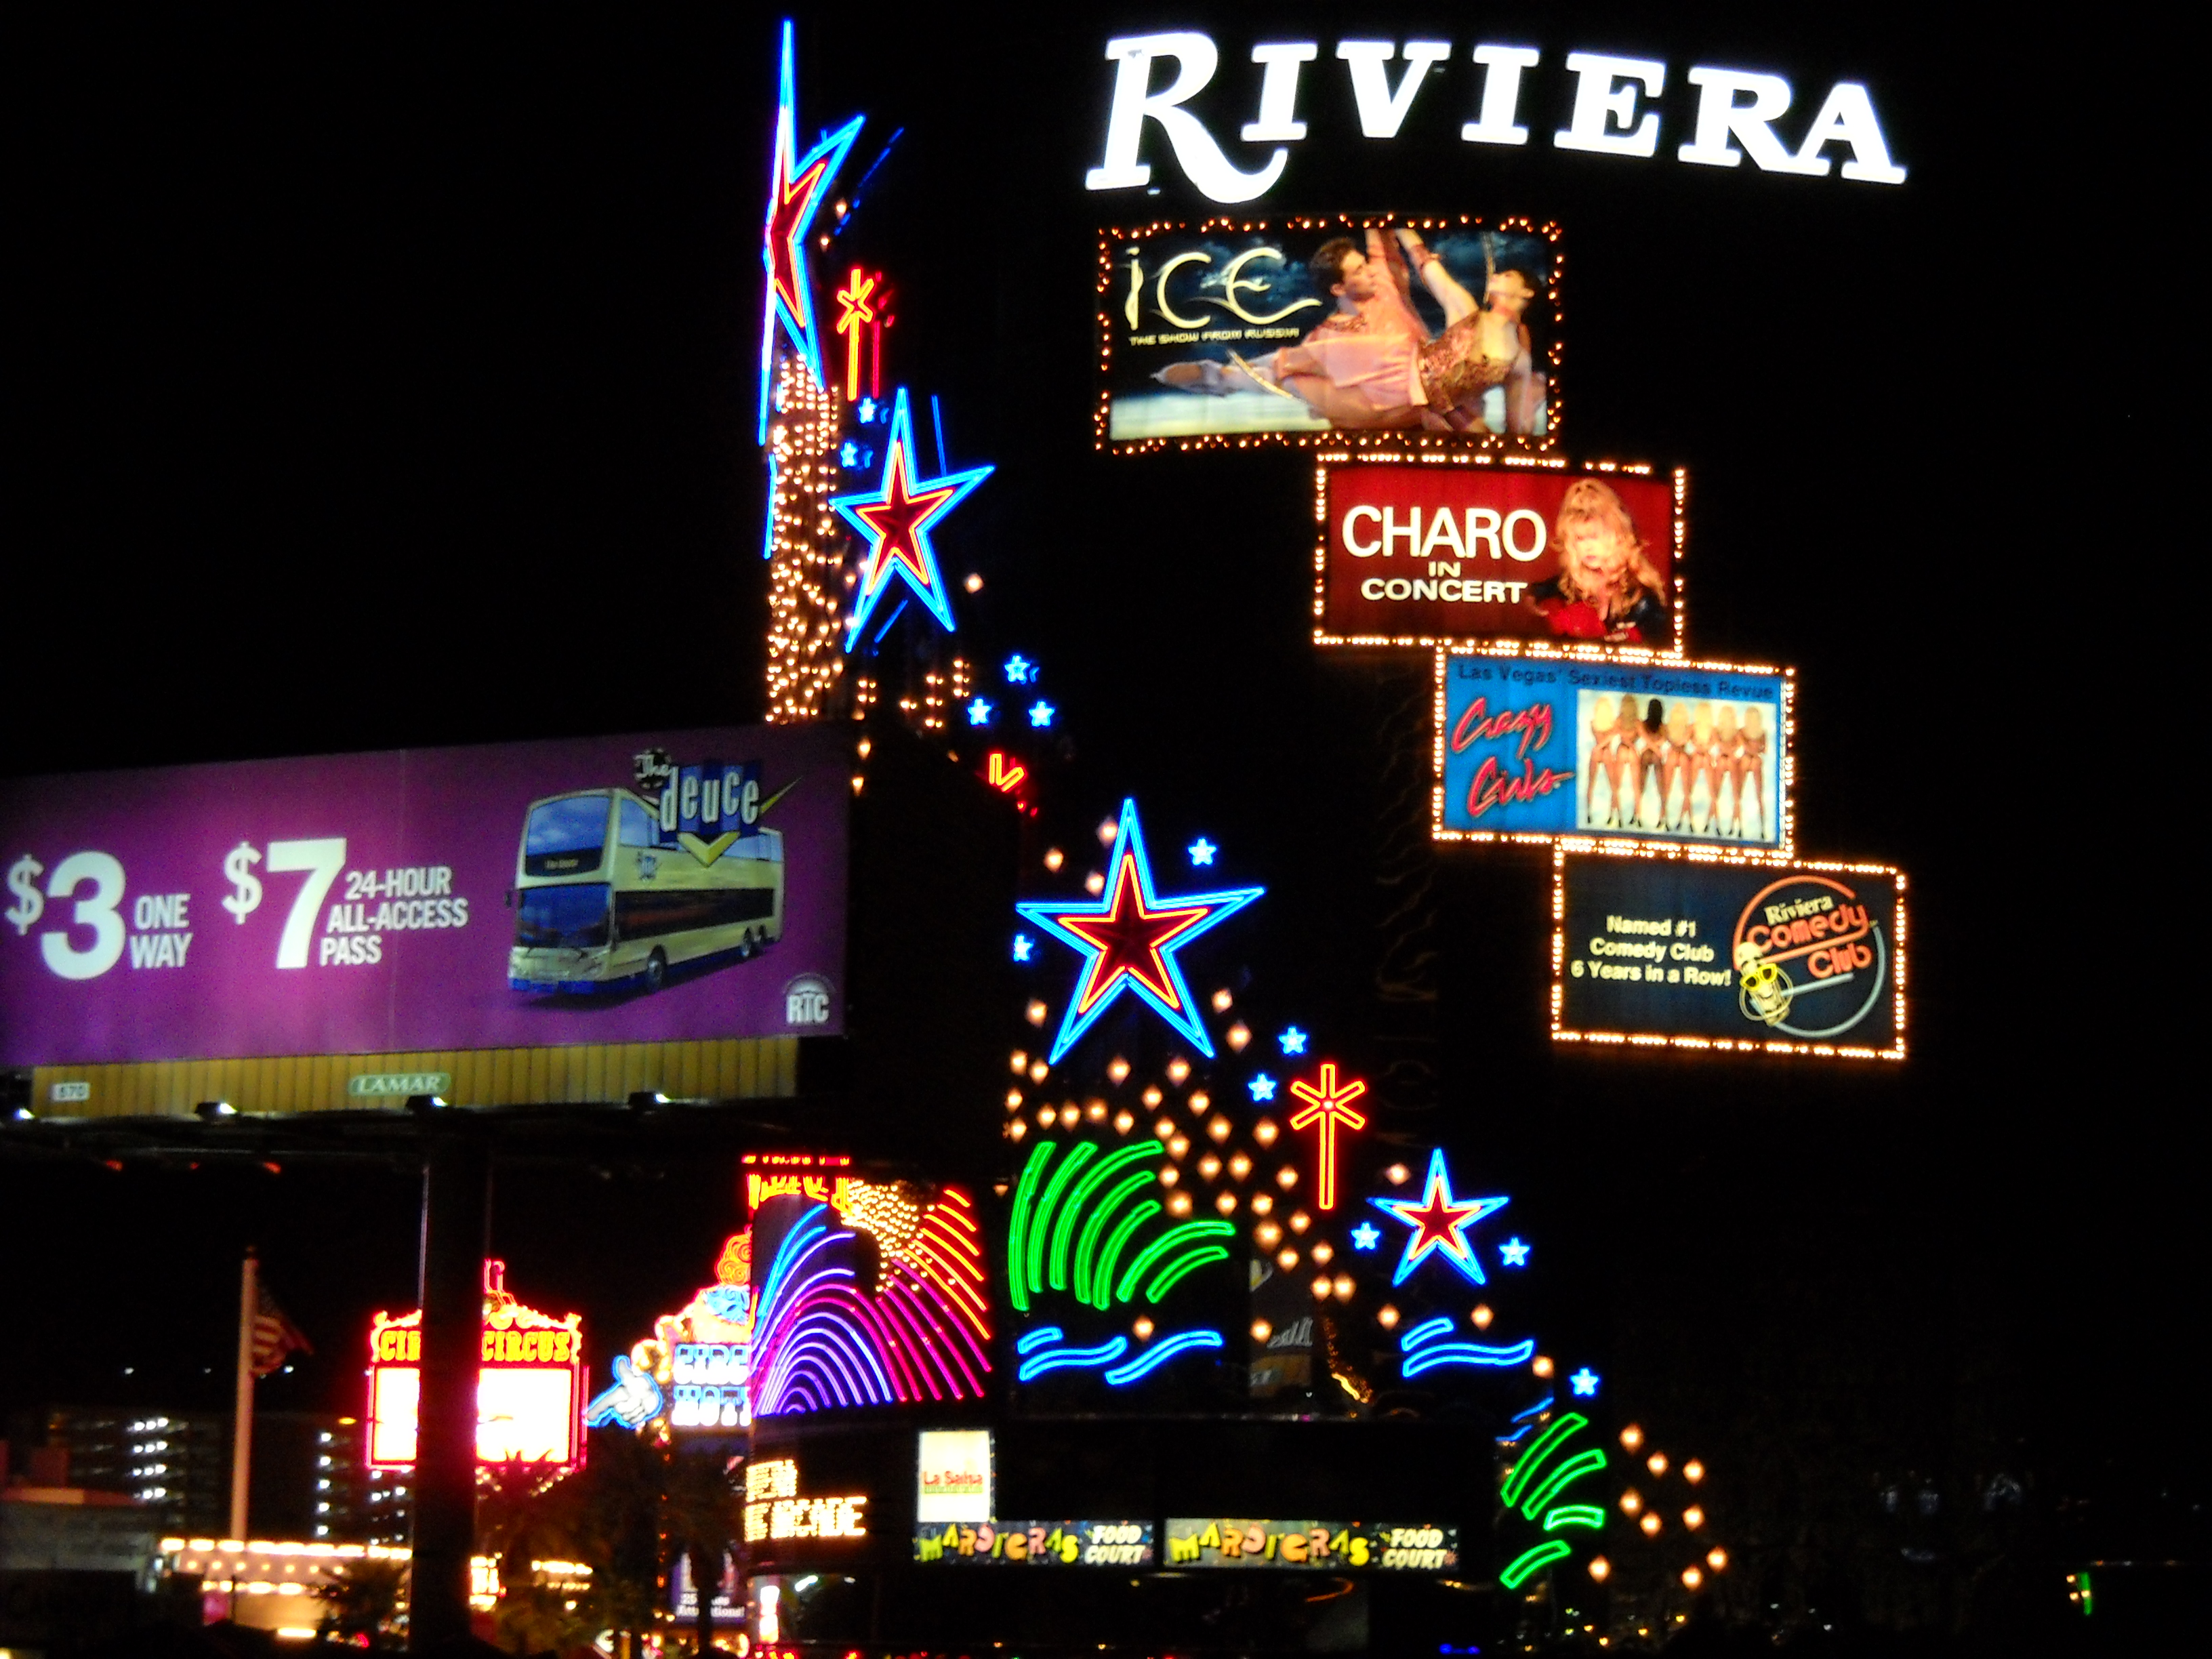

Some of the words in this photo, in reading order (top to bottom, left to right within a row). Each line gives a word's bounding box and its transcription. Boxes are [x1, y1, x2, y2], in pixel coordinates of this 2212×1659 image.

[1085, 31, 1907, 204] RIVIERA
[1130, 336, 1156, 346] THE
[1158, 332, 1200, 345] SHOW
[1201, 330, 1243, 341] FROM
[1245, 328, 1300, 340] RUSSIA
[1342, 505, 1547, 561] CHARO
[1428, 561, 1461, 578] IN
[1360, 577, 1528, 603] CONCERT
[1458, 663, 1492, 681] Las
[1568, 668, 1636, 687] Sexiest
[1641, 674, 1712, 696] Topless
[1717, 680, 1774, 699] Revue
[1451, 697, 1551, 760] Crazy
[633, 752, 671, 781] The
[1467, 756, 1575, 817] Girls
[345, 865, 452, 901] 24-HOUR
[5, 851, 126, 980] $3
[135, 893, 190, 930] ONE
[222, 838, 347, 969] $7
[327, 898, 468, 935] ALL-ACCESS
[1764, 895, 1834, 926] Riviera
[1606, 915, 1671, 937] Named
[1675, 920, 1696, 938] #1
[1746, 903, 1870, 953] Comedy
[130, 932, 192, 969] WAY
[319, 935, 382, 966] PASS
[1589, 937, 1666, 963] Comedy
[1670, 943, 1715, 962] Club
[1807, 943, 1872, 979] Club
[1570, 960, 1584, 978] 6
[1587, 960, 1642, 981] Years
[1645, 964, 1664, 983] in
[1666, 968, 1681, 983] a
[1683, 966, 1732, 986] Row!
[785, 992, 829, 1024] RTC
[357, 1076, 441, 1092] LAMAR
[923, 1471, 940, 1485] La
[945, 1471, 983, 1485] Salsa
[918, 1523, 1004, 1561] MARDI
[1004, 1527, 1079, 1563] GRAS
[1092, 1525, 1142, 1544] FOOD
[1168, 1522, 1275, 1562] MARDI
[1280, 1528, 1370, 1566] GRAS
[1390, 1528, 1444, 1548] FOOD
[1084, 1544, 1147, 1563] COURT
[1382, 1549, 1448, 1569] COURT
